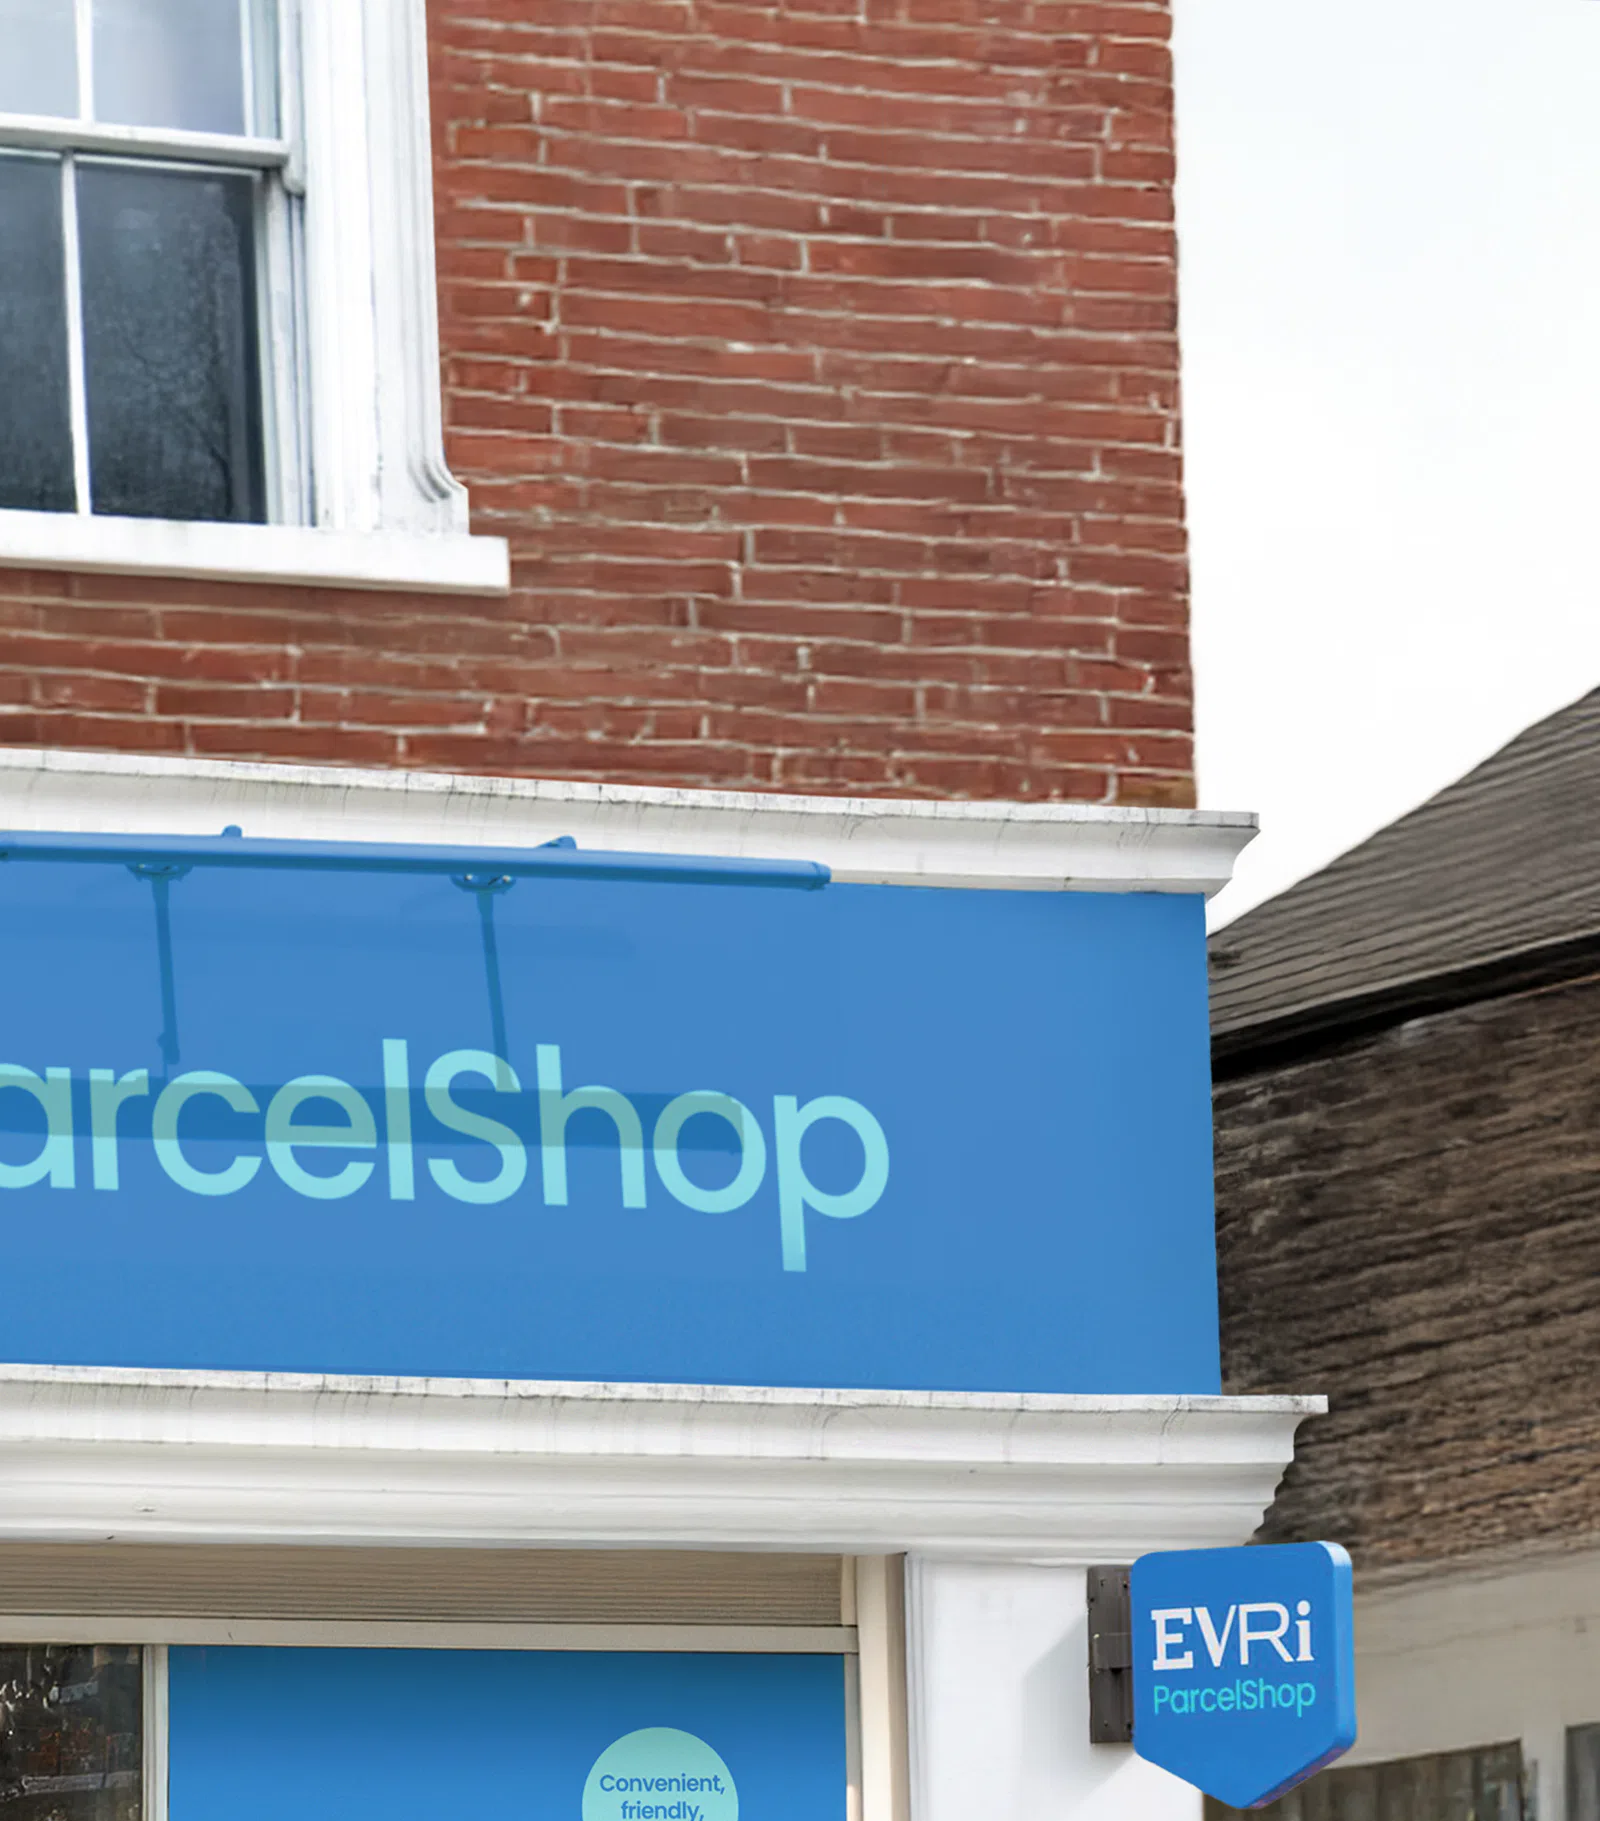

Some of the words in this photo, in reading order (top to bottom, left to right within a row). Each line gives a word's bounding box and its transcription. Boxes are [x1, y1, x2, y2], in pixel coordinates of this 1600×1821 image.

[1151, 1600, 1315, 1671] EVRi
[1153, 1679, 1316, 1718] ParcelShop
[599, 1773, 726, 1796] Convenient,
